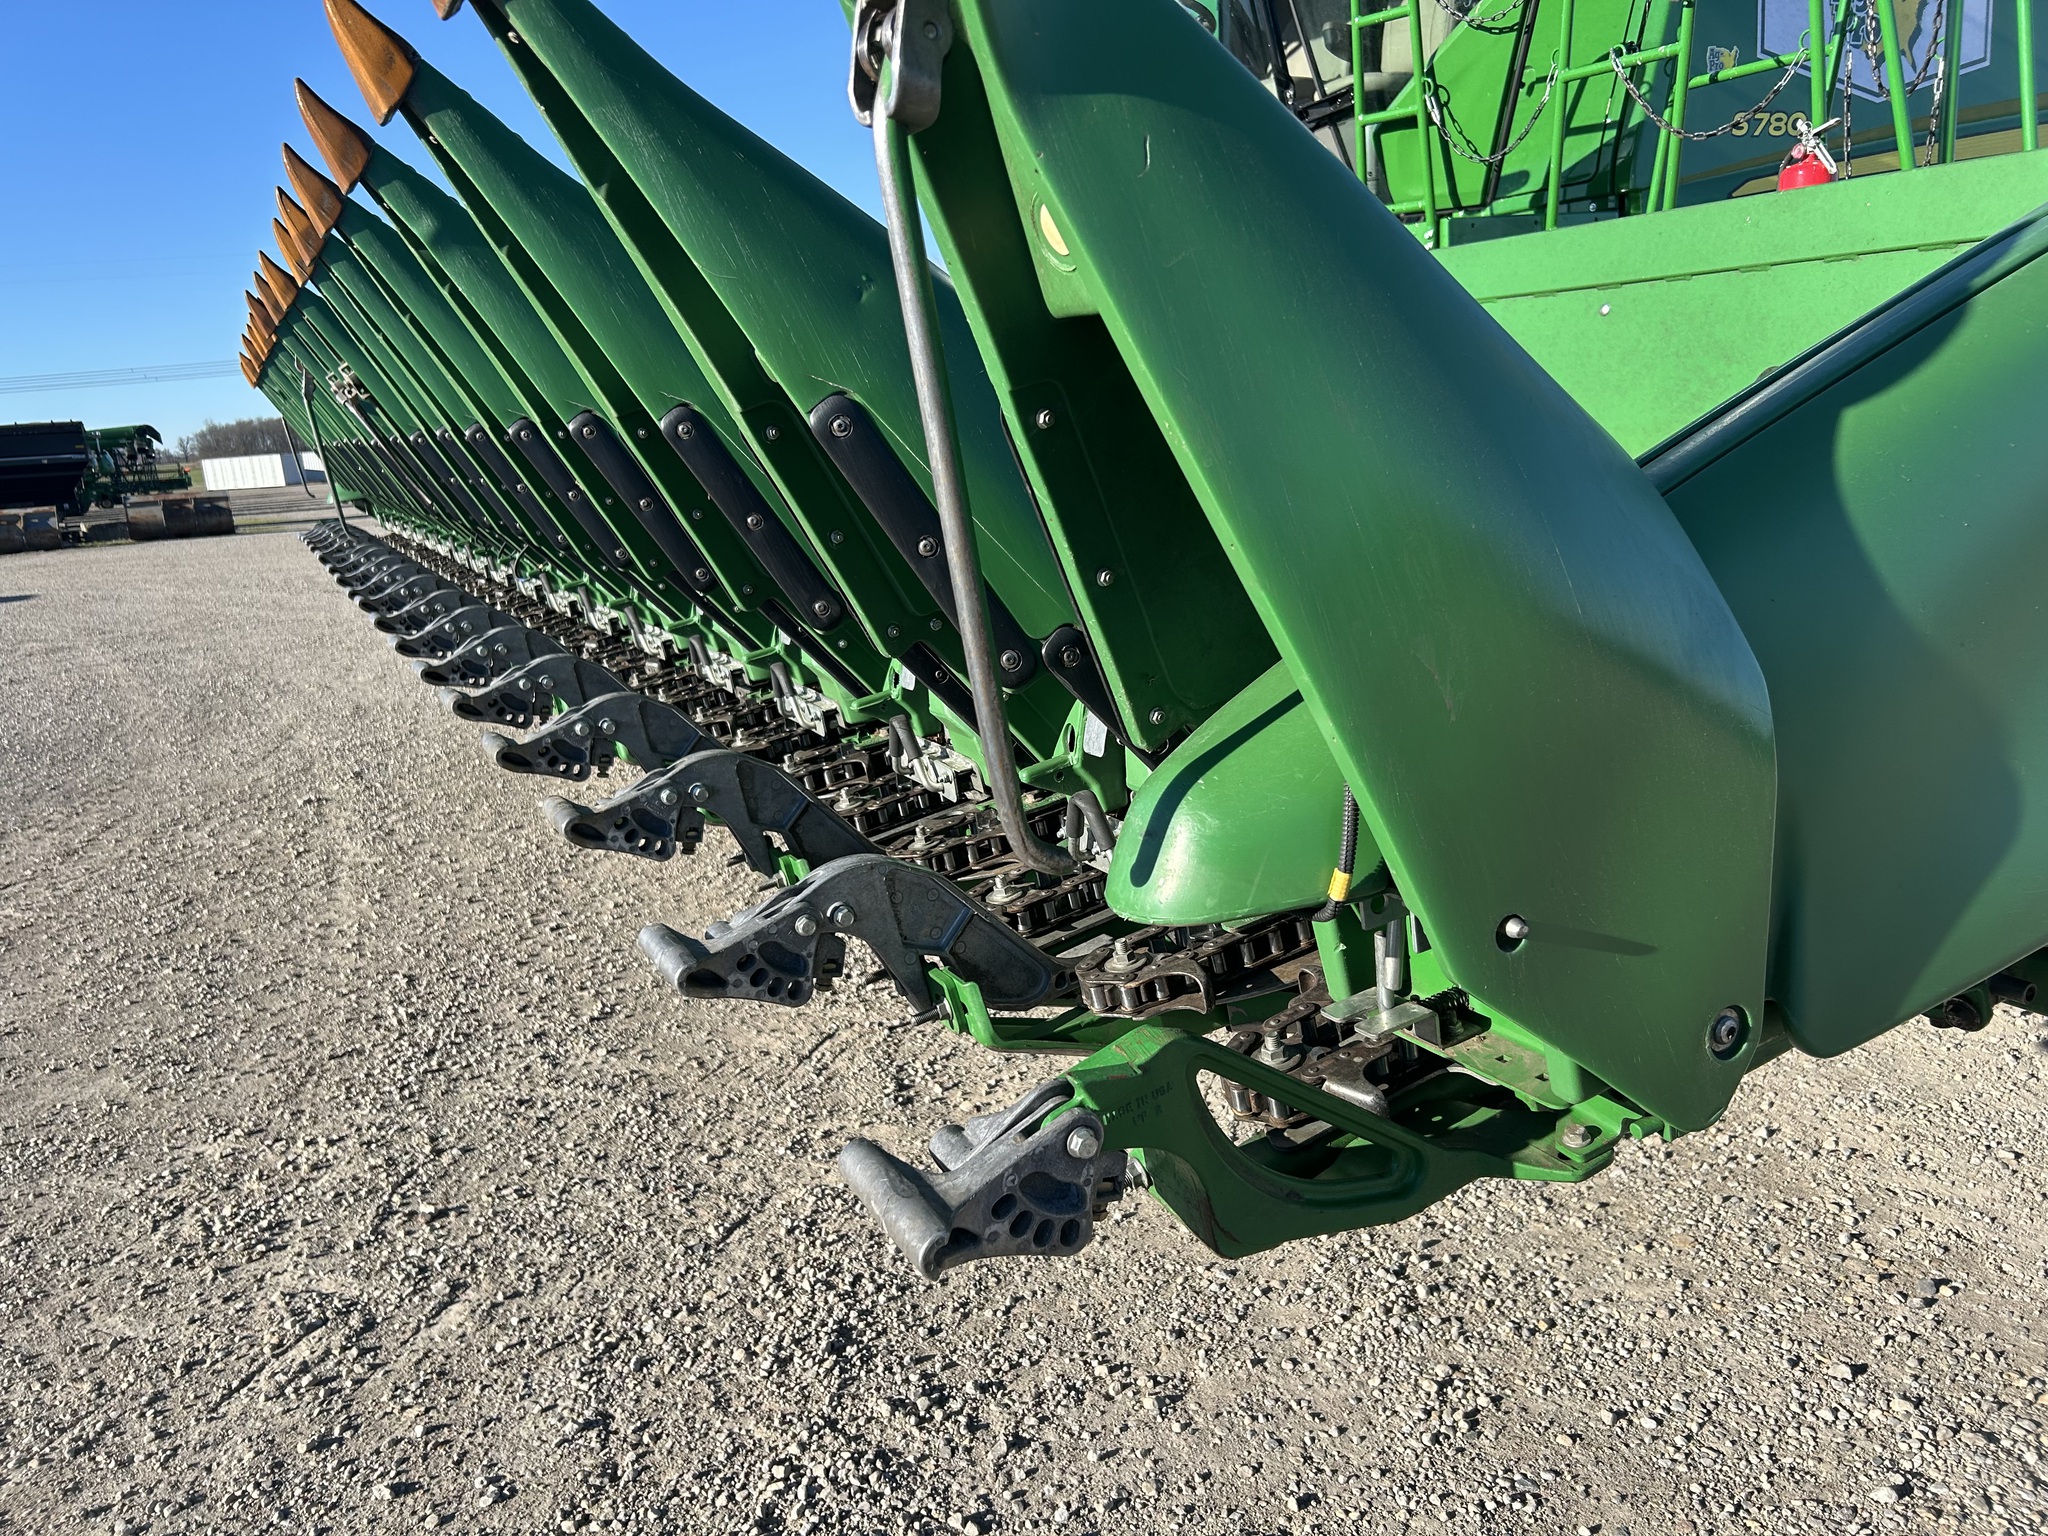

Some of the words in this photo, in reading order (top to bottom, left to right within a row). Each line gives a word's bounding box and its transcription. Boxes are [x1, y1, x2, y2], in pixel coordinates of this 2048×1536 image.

[1731, 111, 1808, 137] S780
[1102, 1102, 1133, 1126] MADE
[1151, 1080, 1175, 1100] USA
